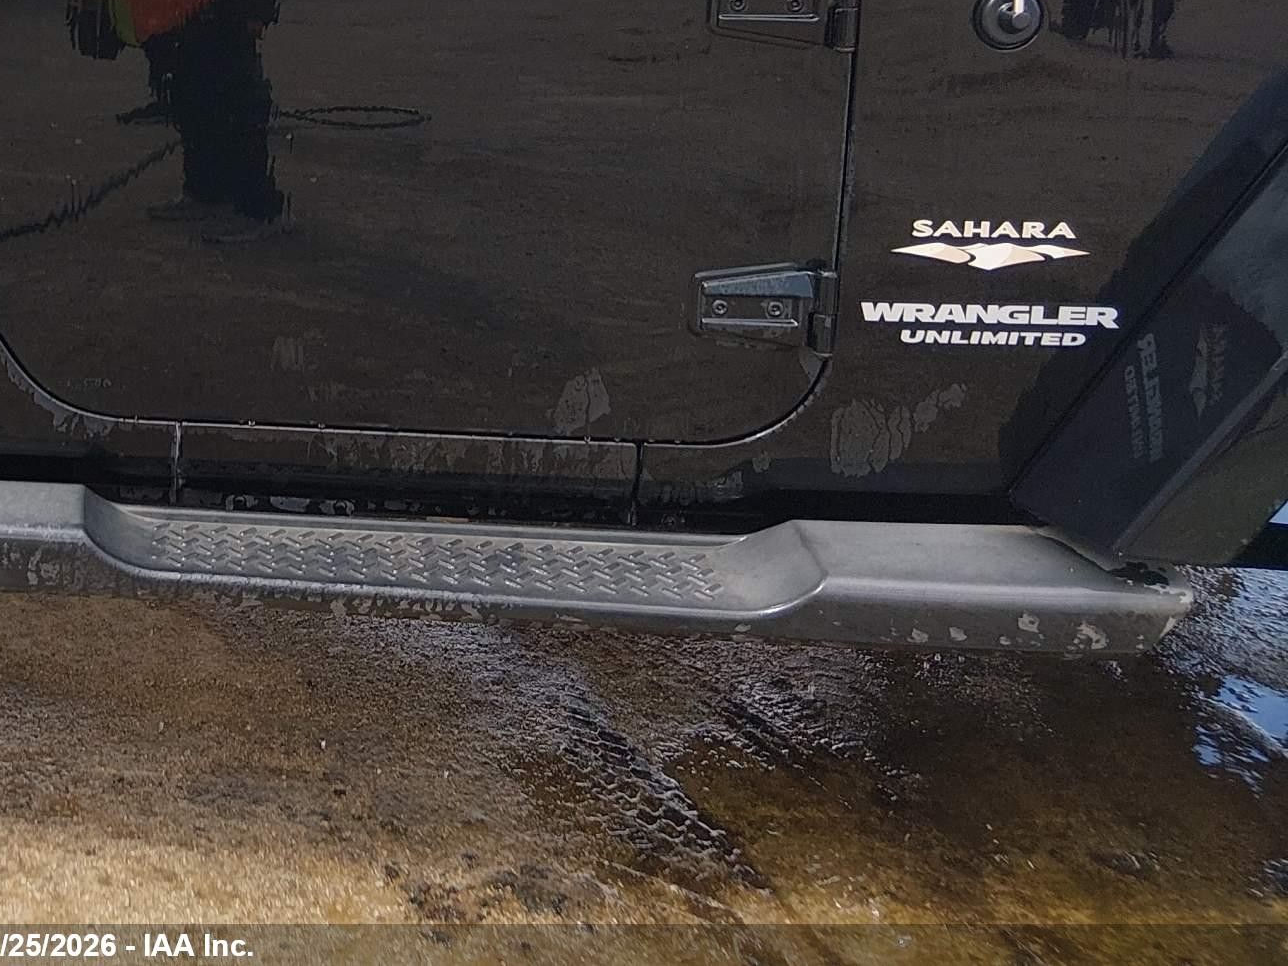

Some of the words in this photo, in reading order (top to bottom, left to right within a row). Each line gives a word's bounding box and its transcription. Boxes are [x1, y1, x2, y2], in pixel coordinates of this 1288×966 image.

[912, 219, 1077, 239] SAHARA
[860, 301, 1121, 329] WRANGLER
[900, 329, 1087, 347] UNLIMITED
